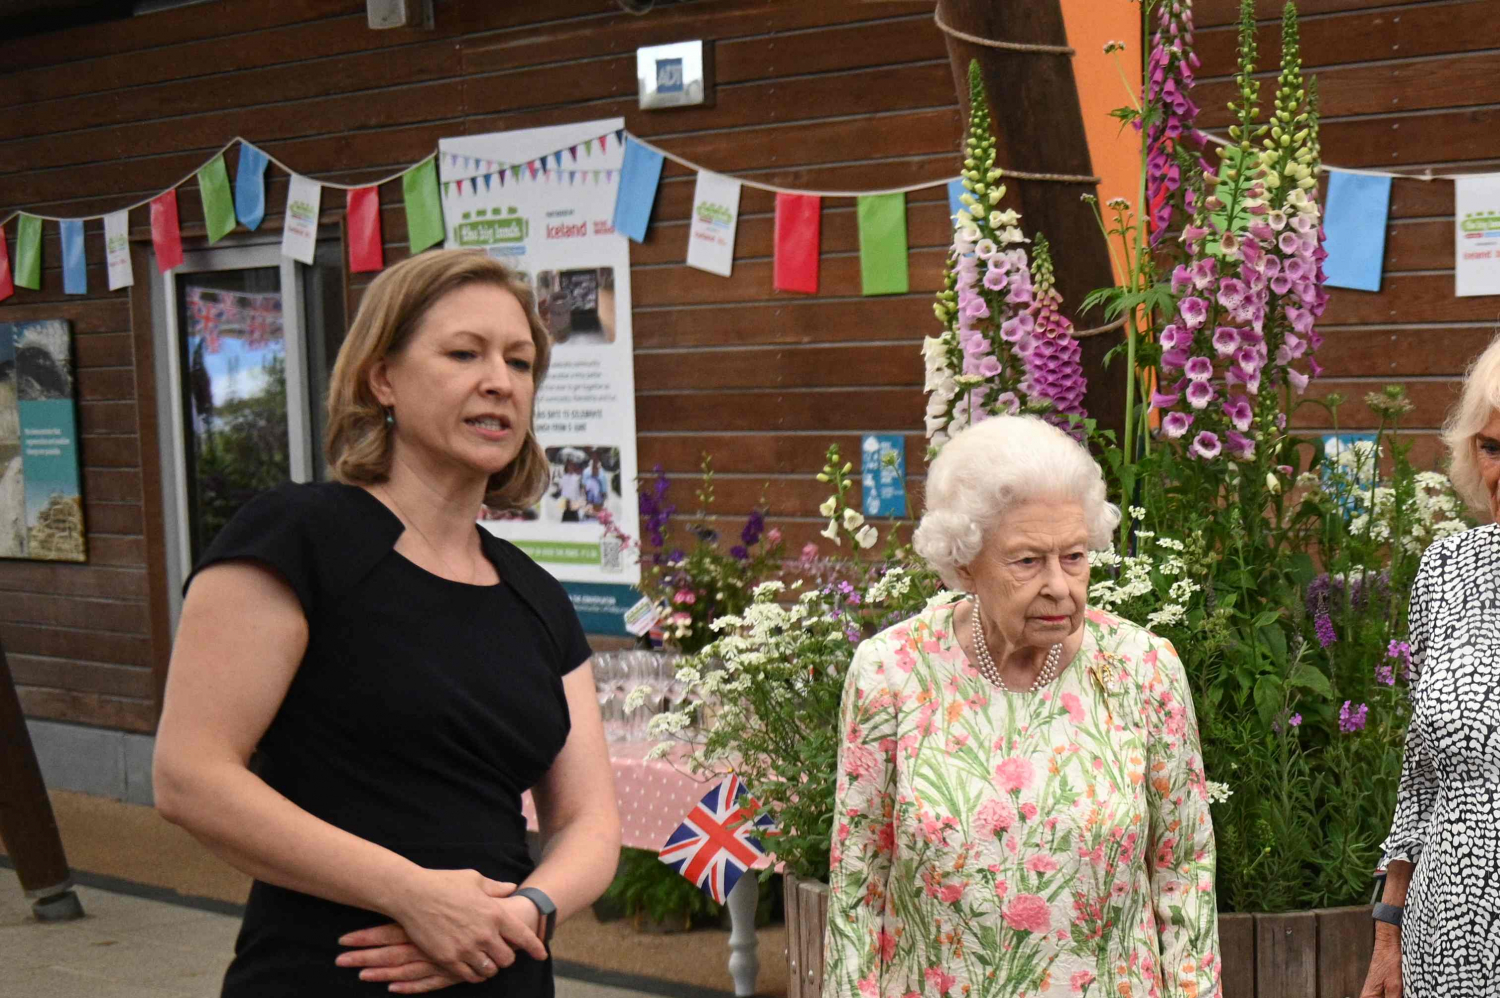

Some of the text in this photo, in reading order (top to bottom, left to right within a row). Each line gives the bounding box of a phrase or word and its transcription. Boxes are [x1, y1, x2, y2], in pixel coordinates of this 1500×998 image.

[658, 64, 683, 87] ADT
[461, 222, 521, 244] the big lunch
[546, 221, 587, 239] Iceland
